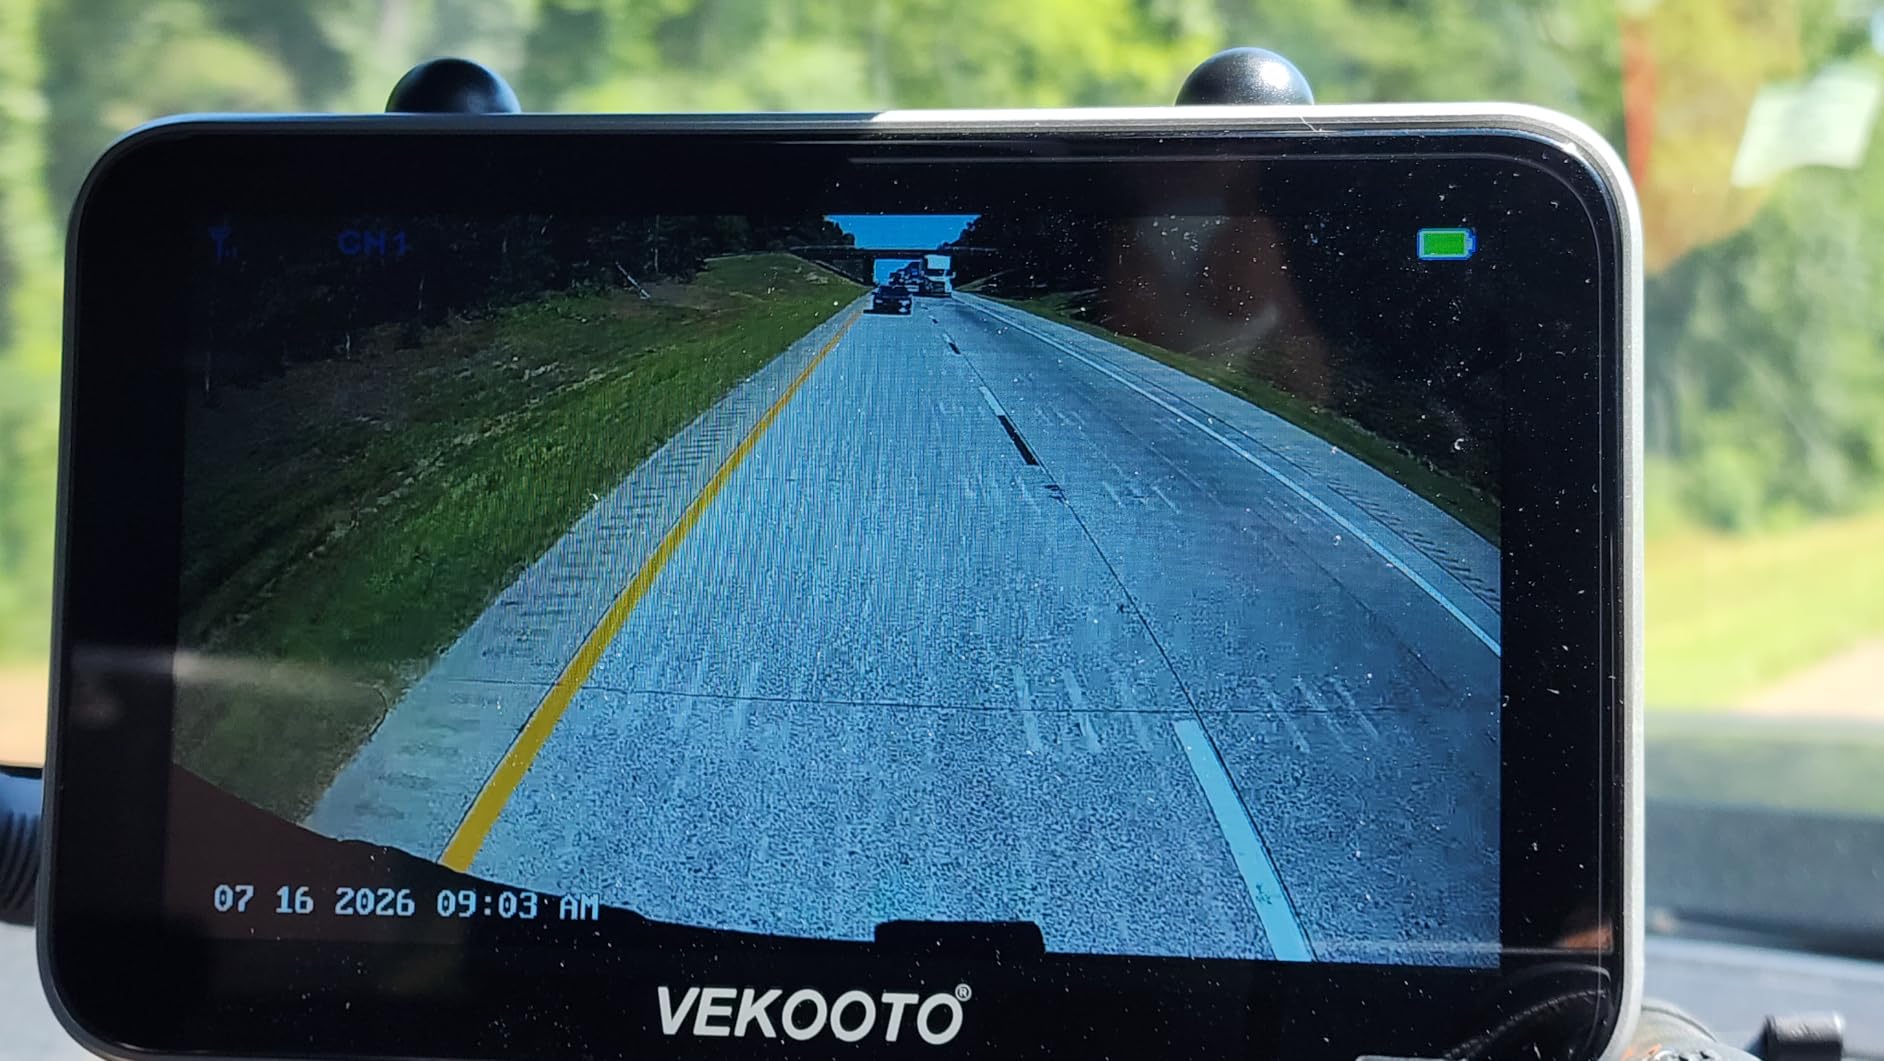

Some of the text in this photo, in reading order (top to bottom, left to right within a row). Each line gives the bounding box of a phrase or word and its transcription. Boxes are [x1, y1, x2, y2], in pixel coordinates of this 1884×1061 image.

[213, 884, 600, 921] 07 16 2026 09:03 AM
